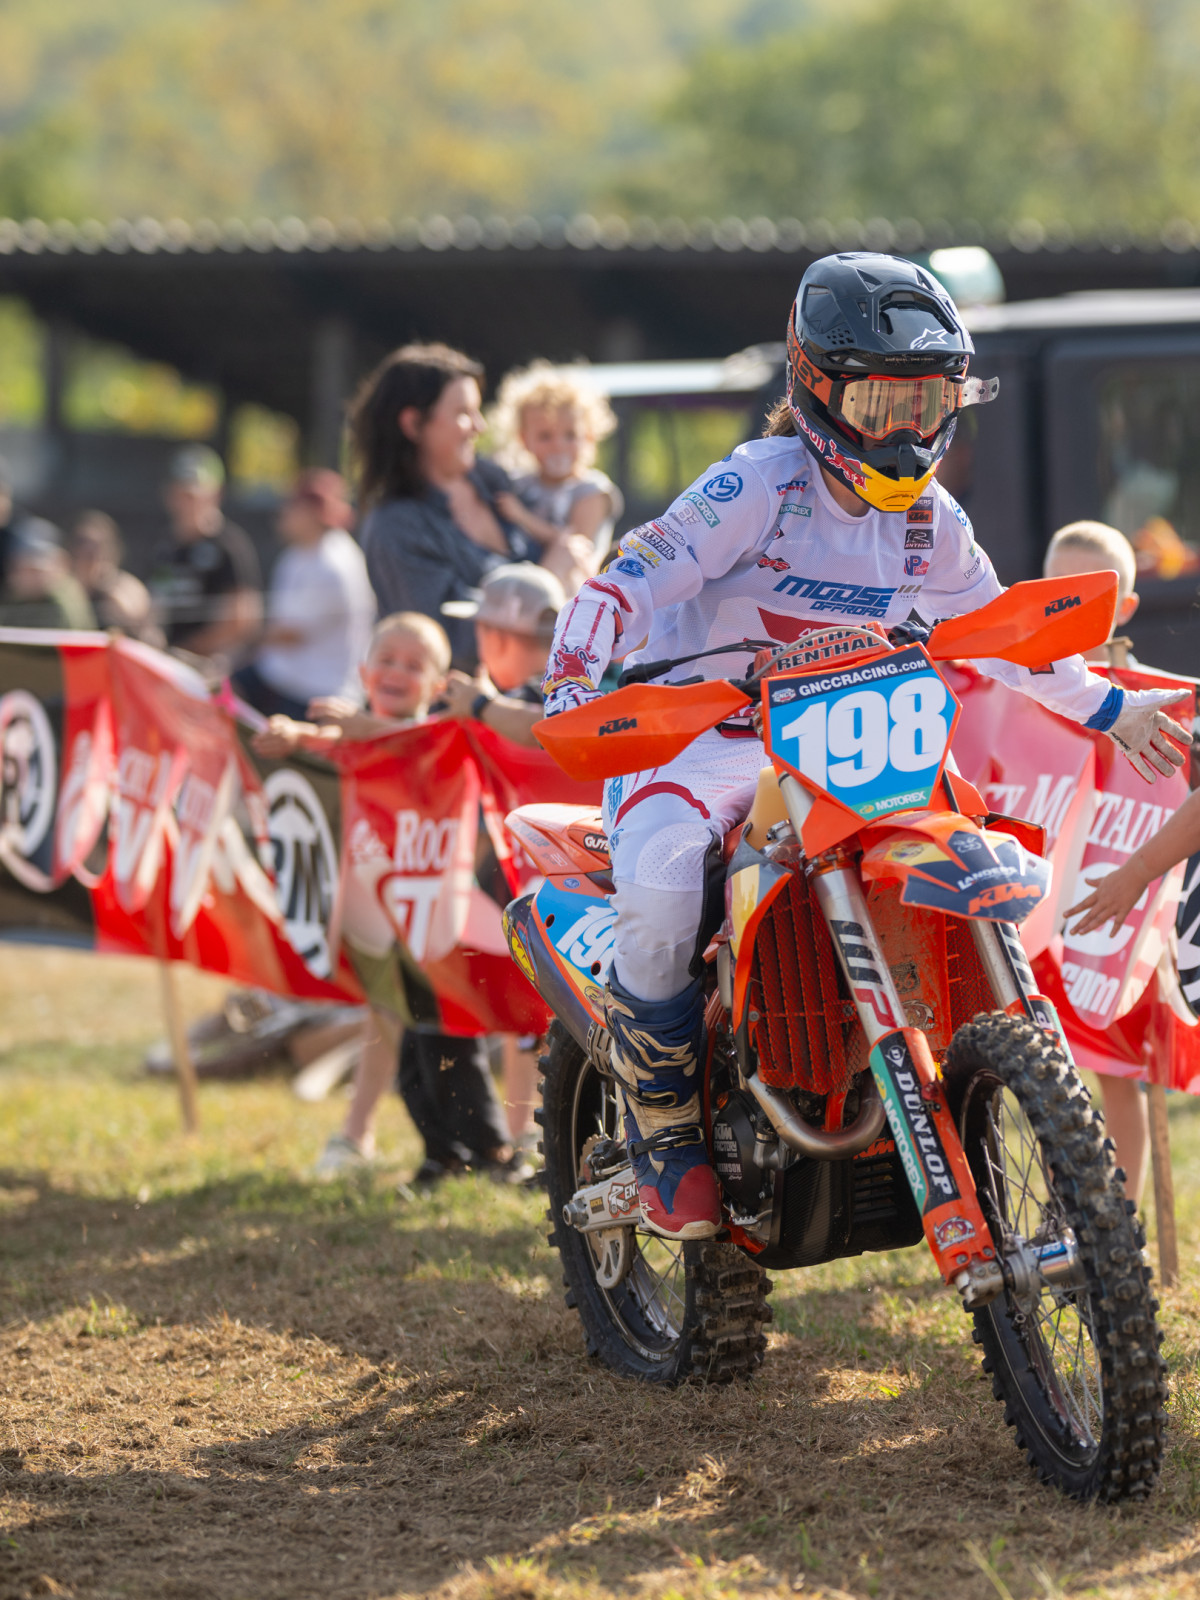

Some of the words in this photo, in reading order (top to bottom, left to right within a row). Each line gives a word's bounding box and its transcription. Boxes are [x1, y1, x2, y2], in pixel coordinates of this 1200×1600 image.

[773, 575, 898, 608] MOOSE
[1045, 596, 1081, 617] KTM
[772, 624, 874, 656] RNTHAL
[777, 636, 881, 672] RENTHAL
[598, 717, 637, 736] KTM
[781, 676, 948, 792] 198
[875, 790, 927, 810] MOTOREX
[968, 881, 1042, 915] KTM
[555, 904, 619, 978] 19
[714, 1123, 733, 1140] KTM
[884, 1097, 925, 1194] MOTOREX
[895, 1071, 953, 1196] DUNLOP
